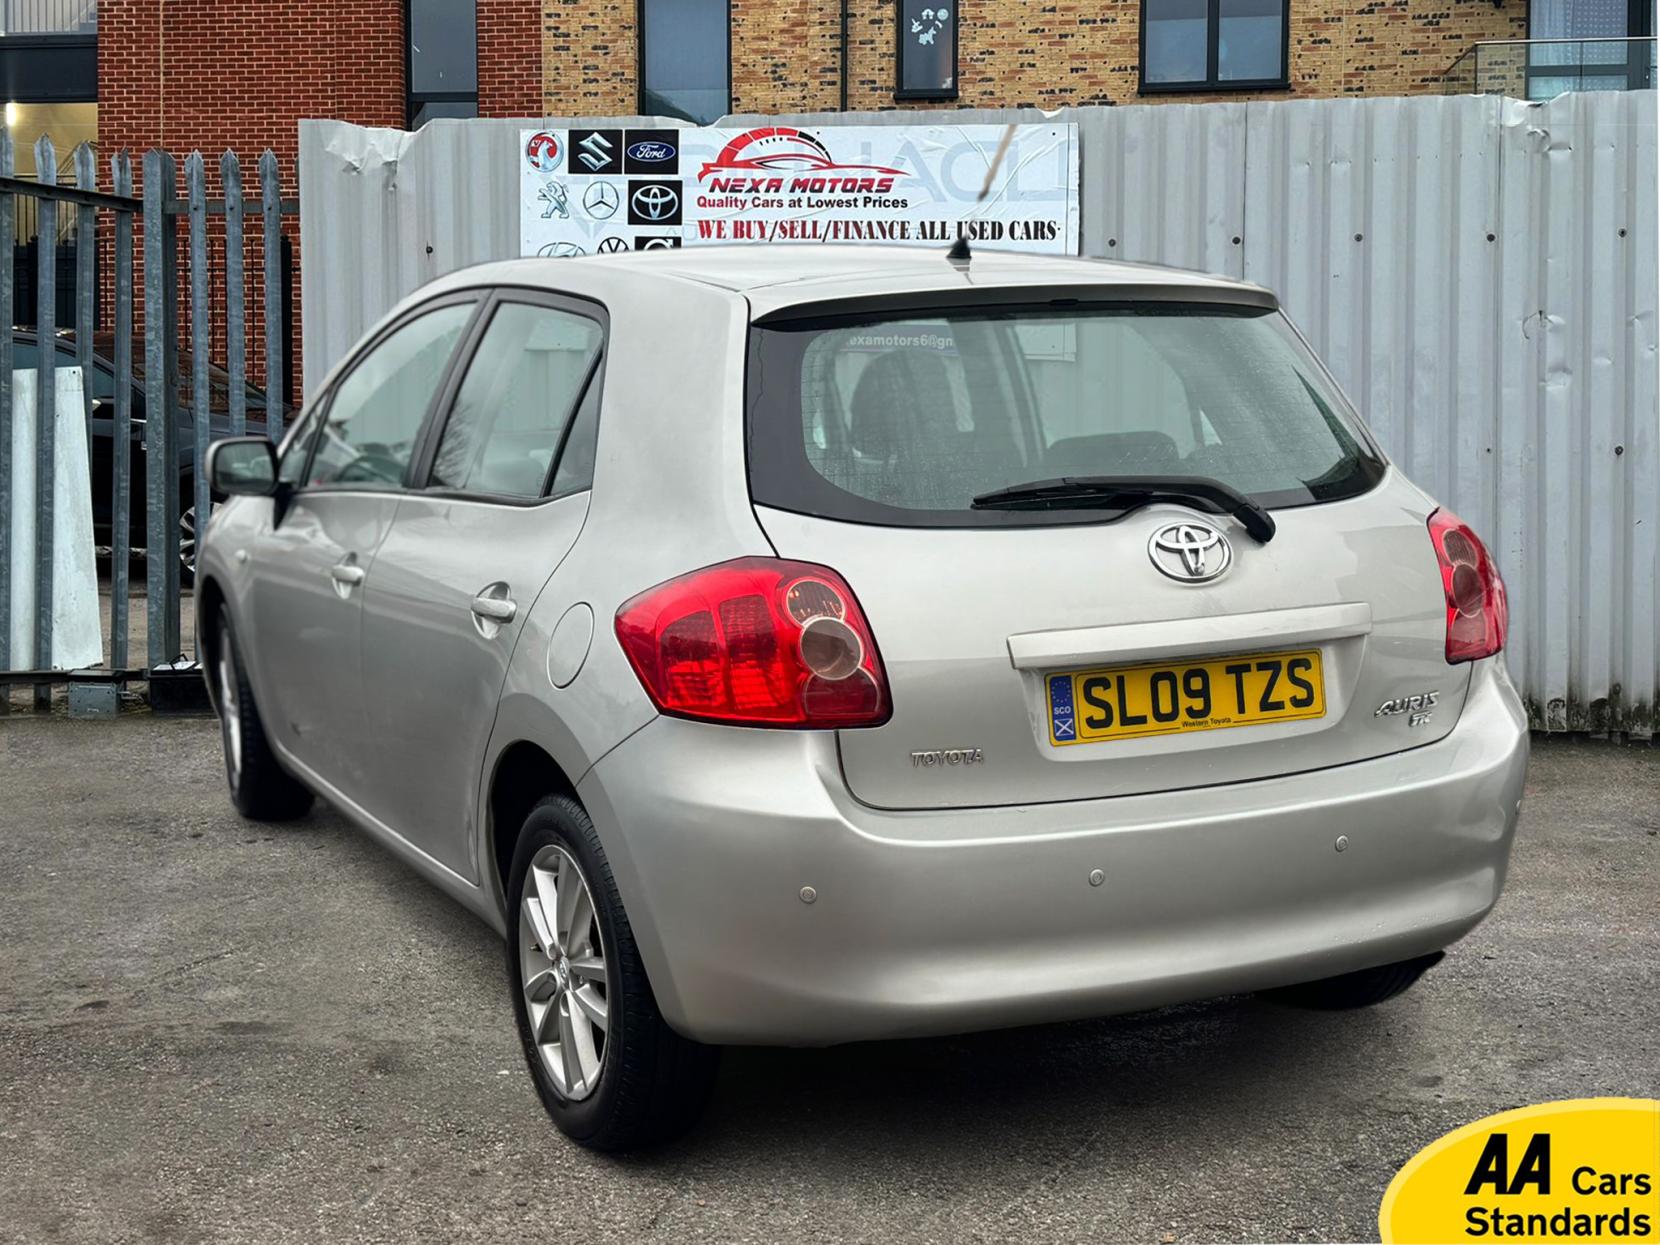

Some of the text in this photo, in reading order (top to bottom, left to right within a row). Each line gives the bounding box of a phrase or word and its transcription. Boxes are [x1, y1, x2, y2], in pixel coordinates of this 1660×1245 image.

[636, 145, 666, 159] Ford
[708, 178, 894, 194] NEXA MOTORS
[697, 196, 908, 210] Quality Cars at Lowest Prices
[697, 220, 726, 239] WE
[733, 220, 911, 242] BUY/SELL/FINANCE
[916, 220, 950, 240] ALL
[957, 220, 1004, 240] USED
[1082, 657, 1315, 730] SL09 TZS
[1053, 706, 1072, 716] SCO
[1374, 690, 1440, 718] AURIS
[1210, 717, 1232, 726] Toyota
[911, 748, 983, 768] TOYOTA
